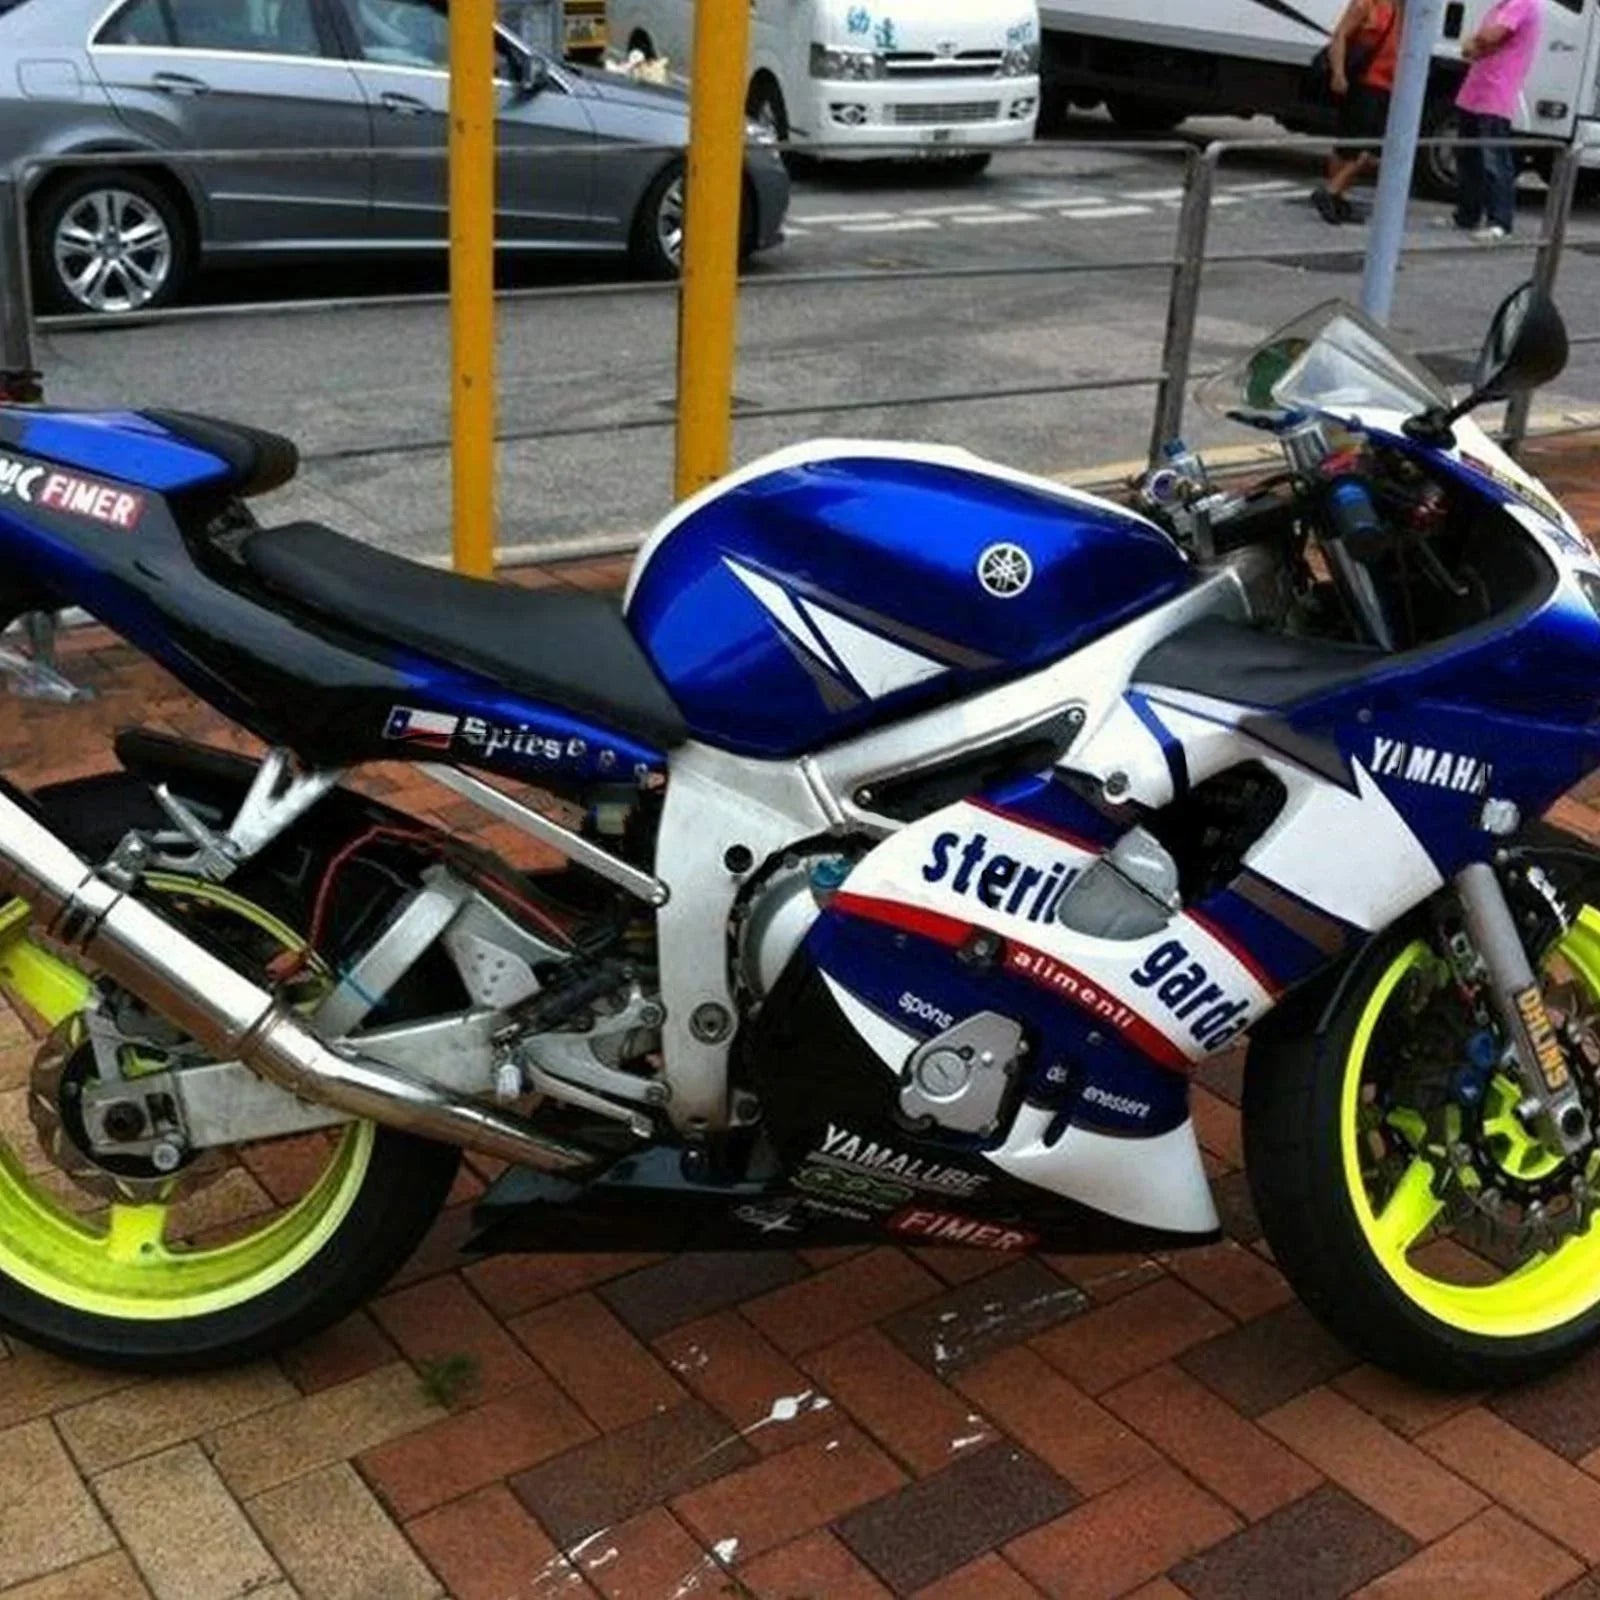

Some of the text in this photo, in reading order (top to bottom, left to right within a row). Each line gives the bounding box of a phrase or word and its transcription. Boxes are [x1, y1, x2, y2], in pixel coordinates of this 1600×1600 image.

[41, 473, 136, 526] FIMER
[1370, 736, 1493, 795] YAMAHA
[922, 832, 1080, 924] steril
[1013, 951, 1137, 1028] alimenti
[820, 1123, 990, 1192] YAMALUBE
[900, 1211, 1026, 1250] FIMER
